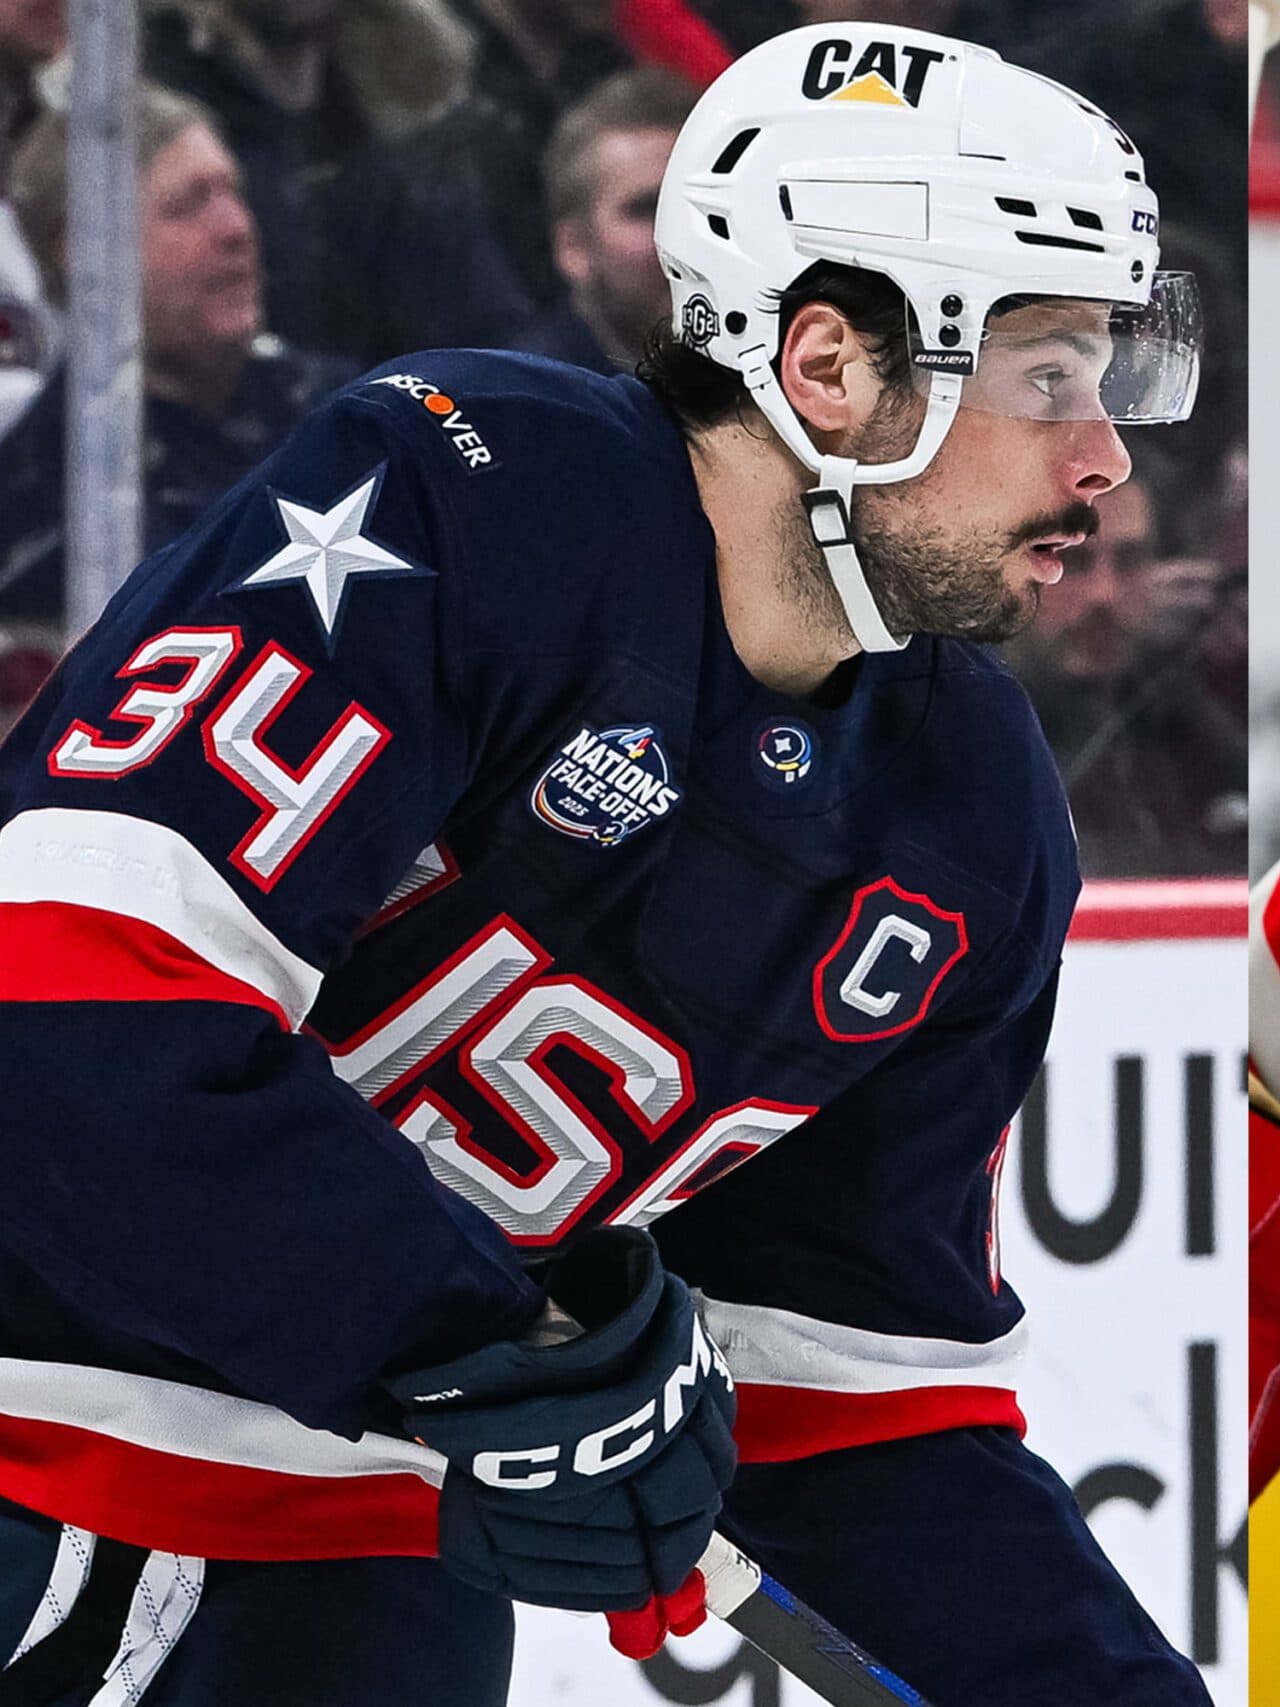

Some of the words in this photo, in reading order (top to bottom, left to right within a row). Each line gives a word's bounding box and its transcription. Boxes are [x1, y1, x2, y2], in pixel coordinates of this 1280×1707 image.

[801, 38, 945, 109] CAT
[47, 626, 393, 894] 34
[550, 759, 648, 824] FACE-OFF
[561, 728, 680, 816] NATIONS
[840, 914, 931, 1018] C
[473, 1312, 711, 1489] CCM
